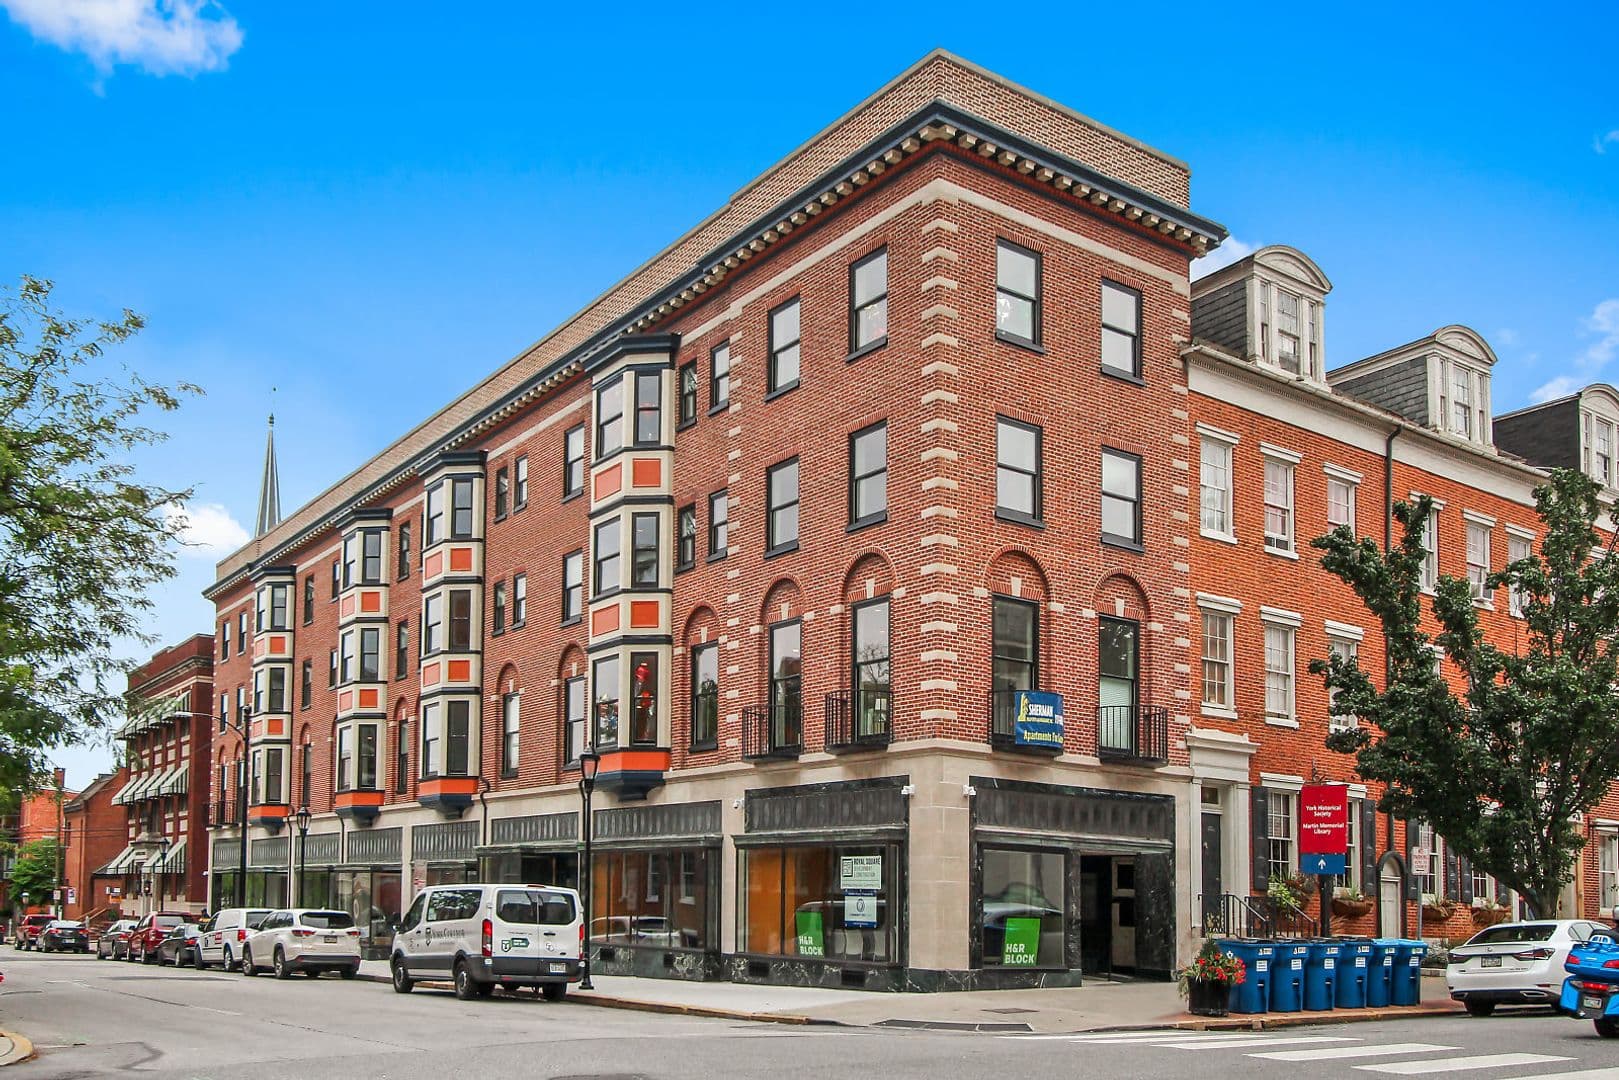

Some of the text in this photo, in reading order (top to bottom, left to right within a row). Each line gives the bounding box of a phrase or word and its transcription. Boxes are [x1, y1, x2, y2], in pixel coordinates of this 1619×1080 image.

[1029, 704, 1053, 717] SHERMAN
[1023, 730, 1051, 742] Apartments
[865, 857, 881, 865] SQUARE
[798, 935, 813, 945] H&R
[799, 946, 824, 956] BLOCK
[1005, 943, 1025, 953] H&R
[1004, 953, 1035, 965] BLOCK
